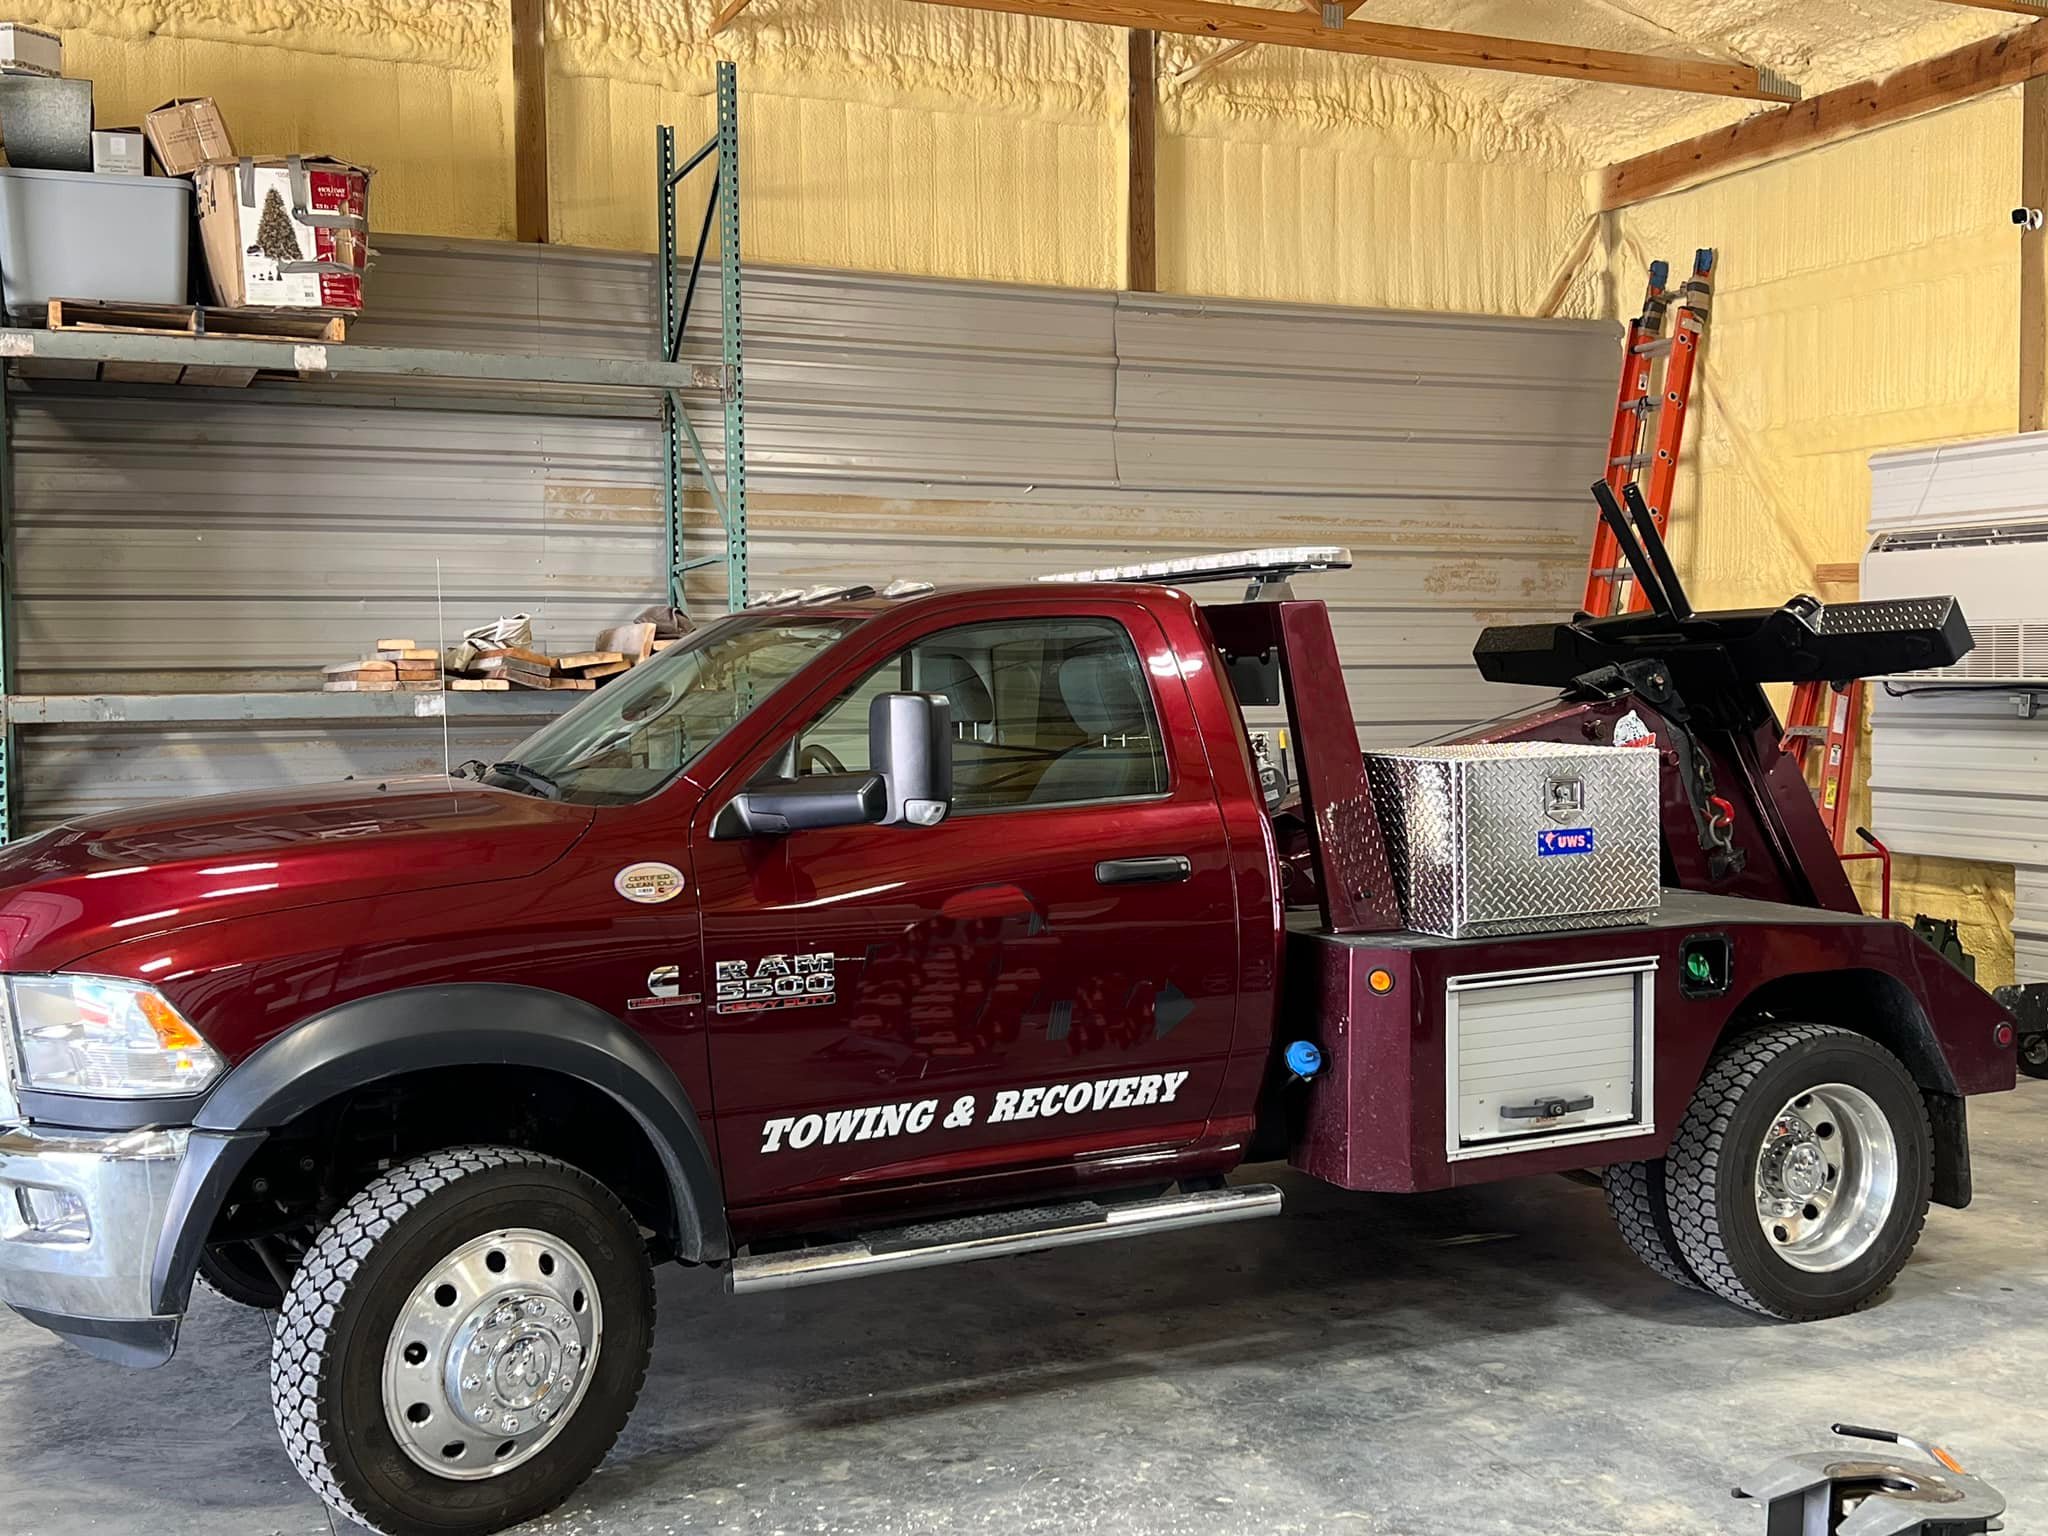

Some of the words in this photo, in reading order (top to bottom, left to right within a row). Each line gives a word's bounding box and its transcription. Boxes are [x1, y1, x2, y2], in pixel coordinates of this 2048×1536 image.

[1557, 835, 1586, 848] UWS
[628, 873, 670, 882] CERTIFIED
[656, 879, 675, 887] IDLE
[715, 952, 835, 980] RAM
[716, 973, 836, 1001] 5500
[721, 1000, 781, 1012] HEAVY
[783, 994, 833, 1006] DUTY
[760, 1099, 939, 1153] TOWING
[943, 1095, 976, 1128] &
[986, 1071, 1190, 1124] RECOVERY
